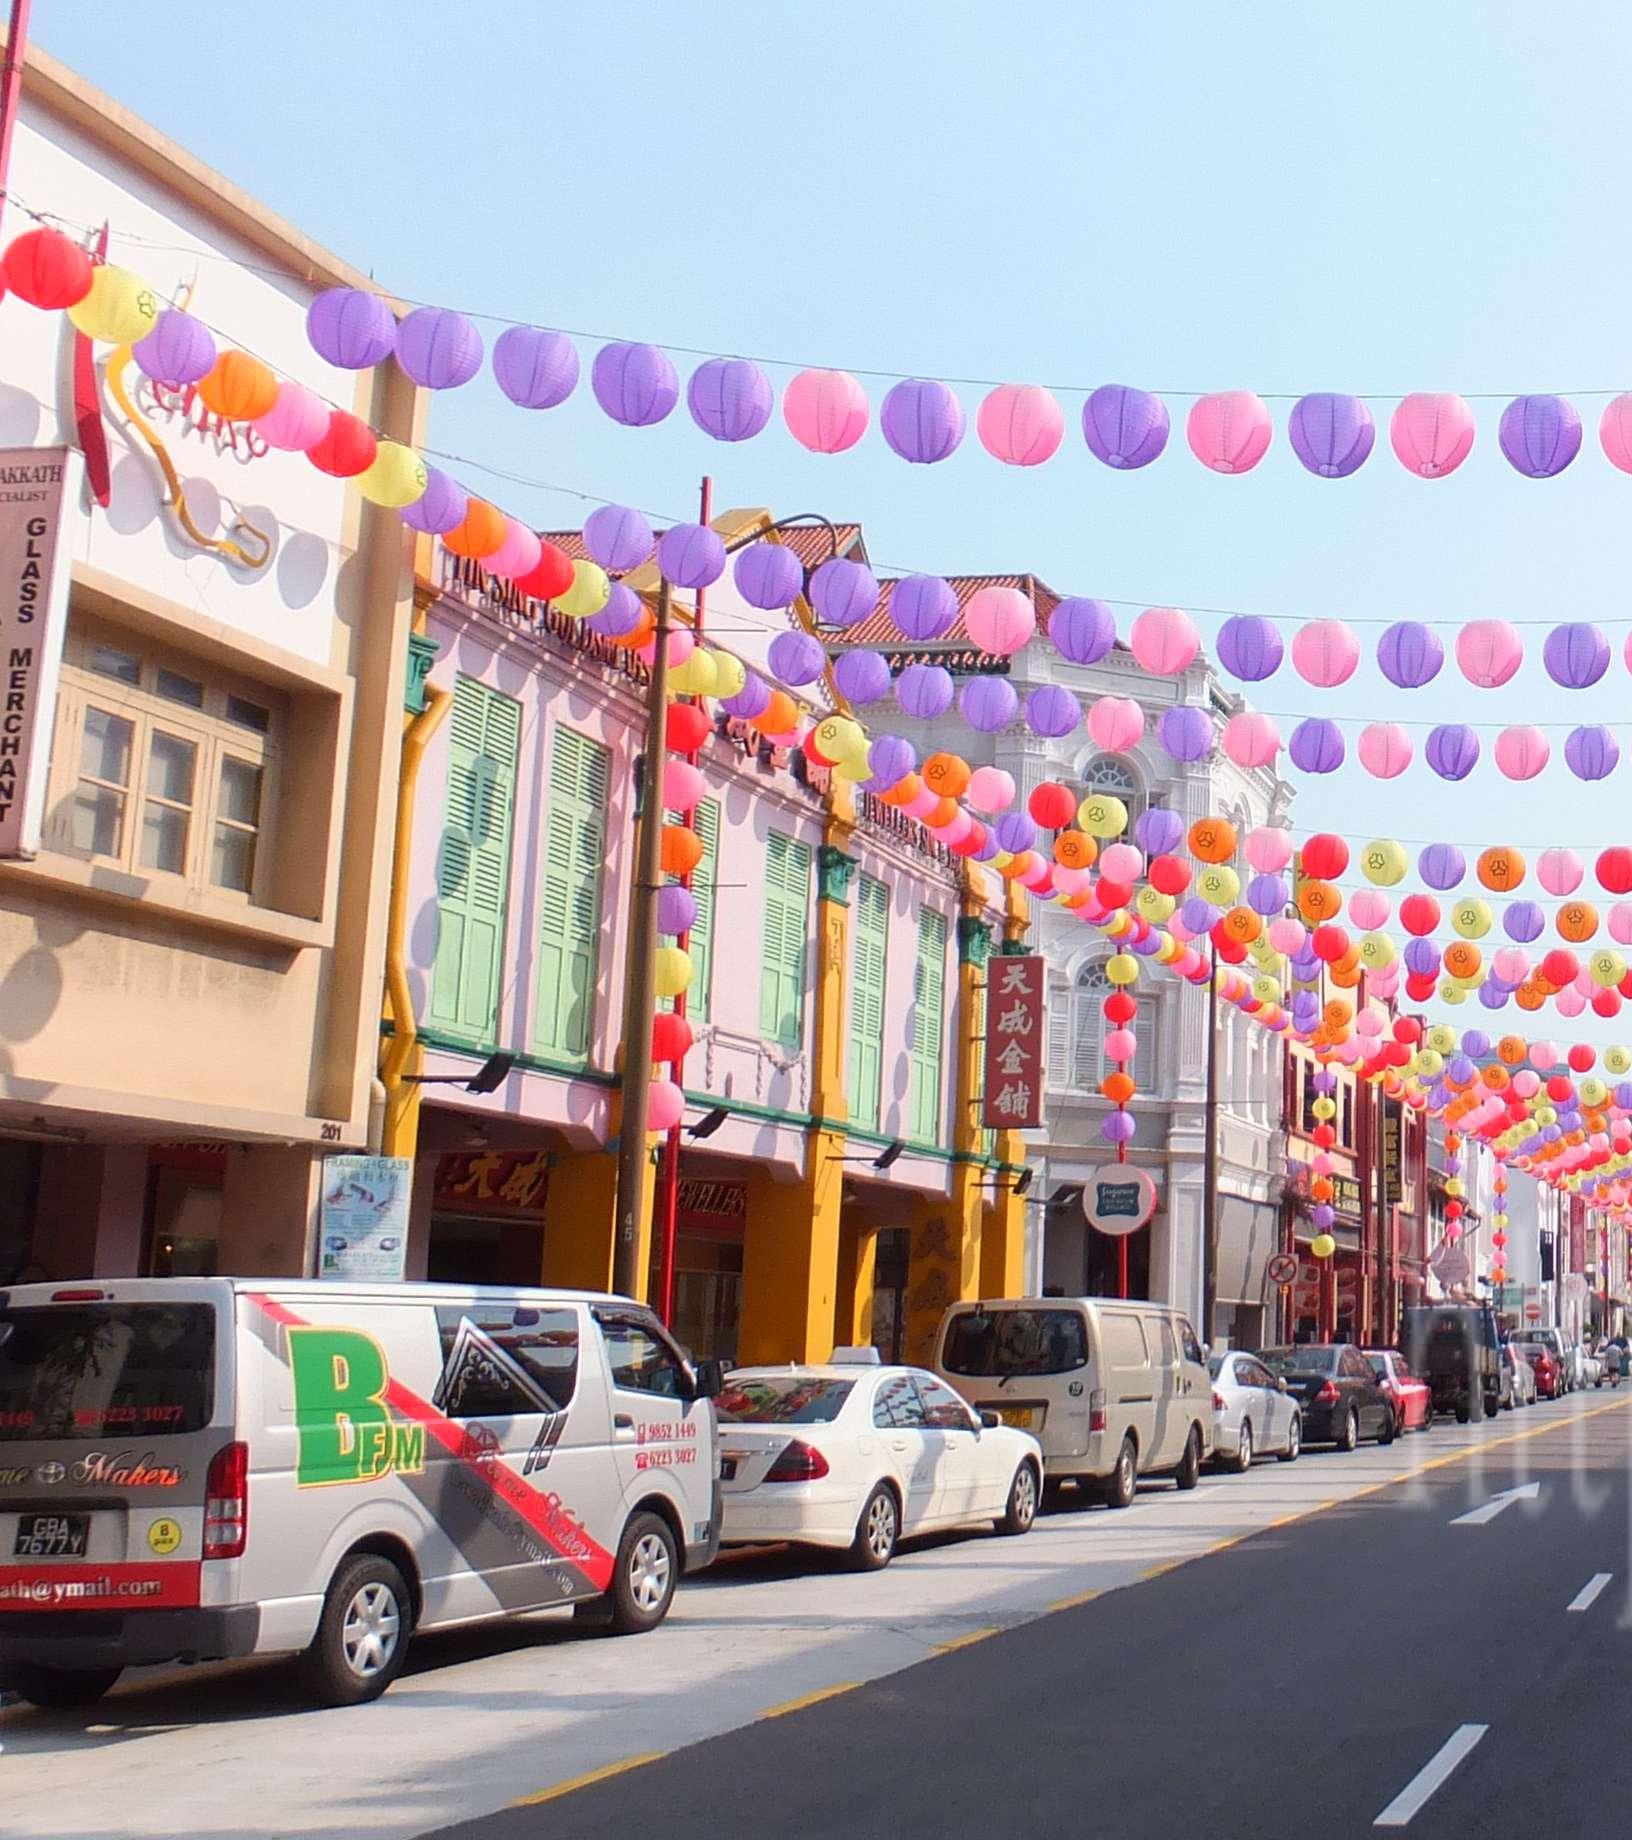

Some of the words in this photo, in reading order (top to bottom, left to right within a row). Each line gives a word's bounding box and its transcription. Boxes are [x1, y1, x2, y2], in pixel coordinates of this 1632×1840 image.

[17, 516, 46, 624] GLASS
[320, 1123, 343, 1142] 201
[71, 1450, 184, 1488] Makers
[33, 1517, 69, 1534] GBA
